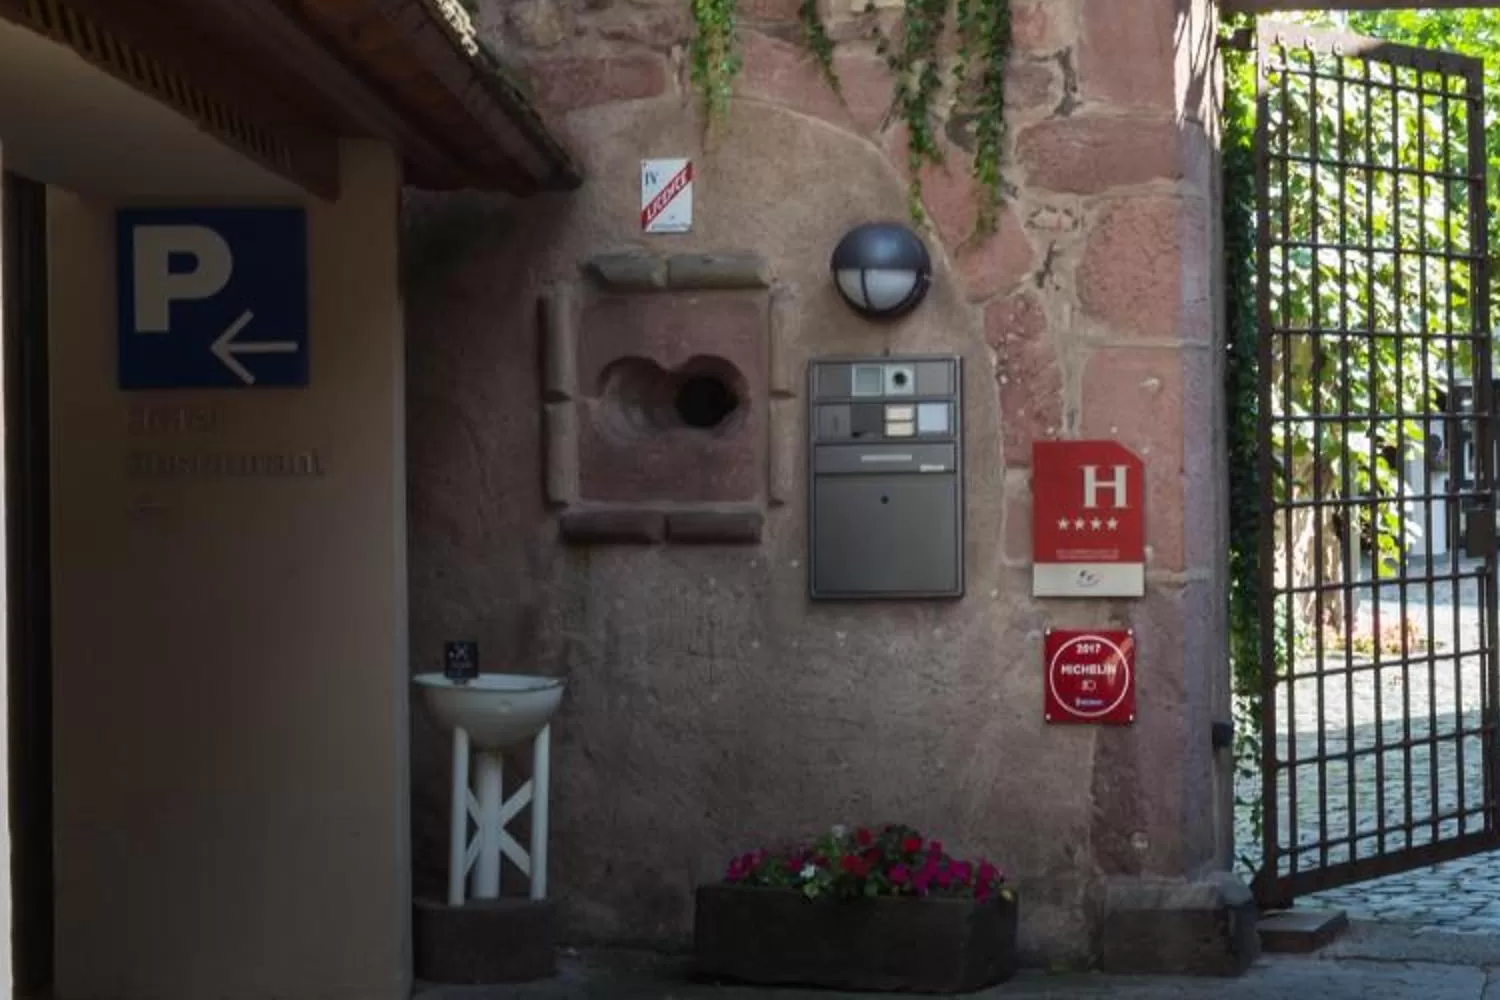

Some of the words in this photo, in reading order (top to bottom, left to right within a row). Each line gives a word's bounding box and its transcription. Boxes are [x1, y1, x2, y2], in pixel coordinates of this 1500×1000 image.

[132, 224, 232, 332] P
[1080, 464, 1131, 508] H
[1061, 663, 1117, 675] MICHELIN
